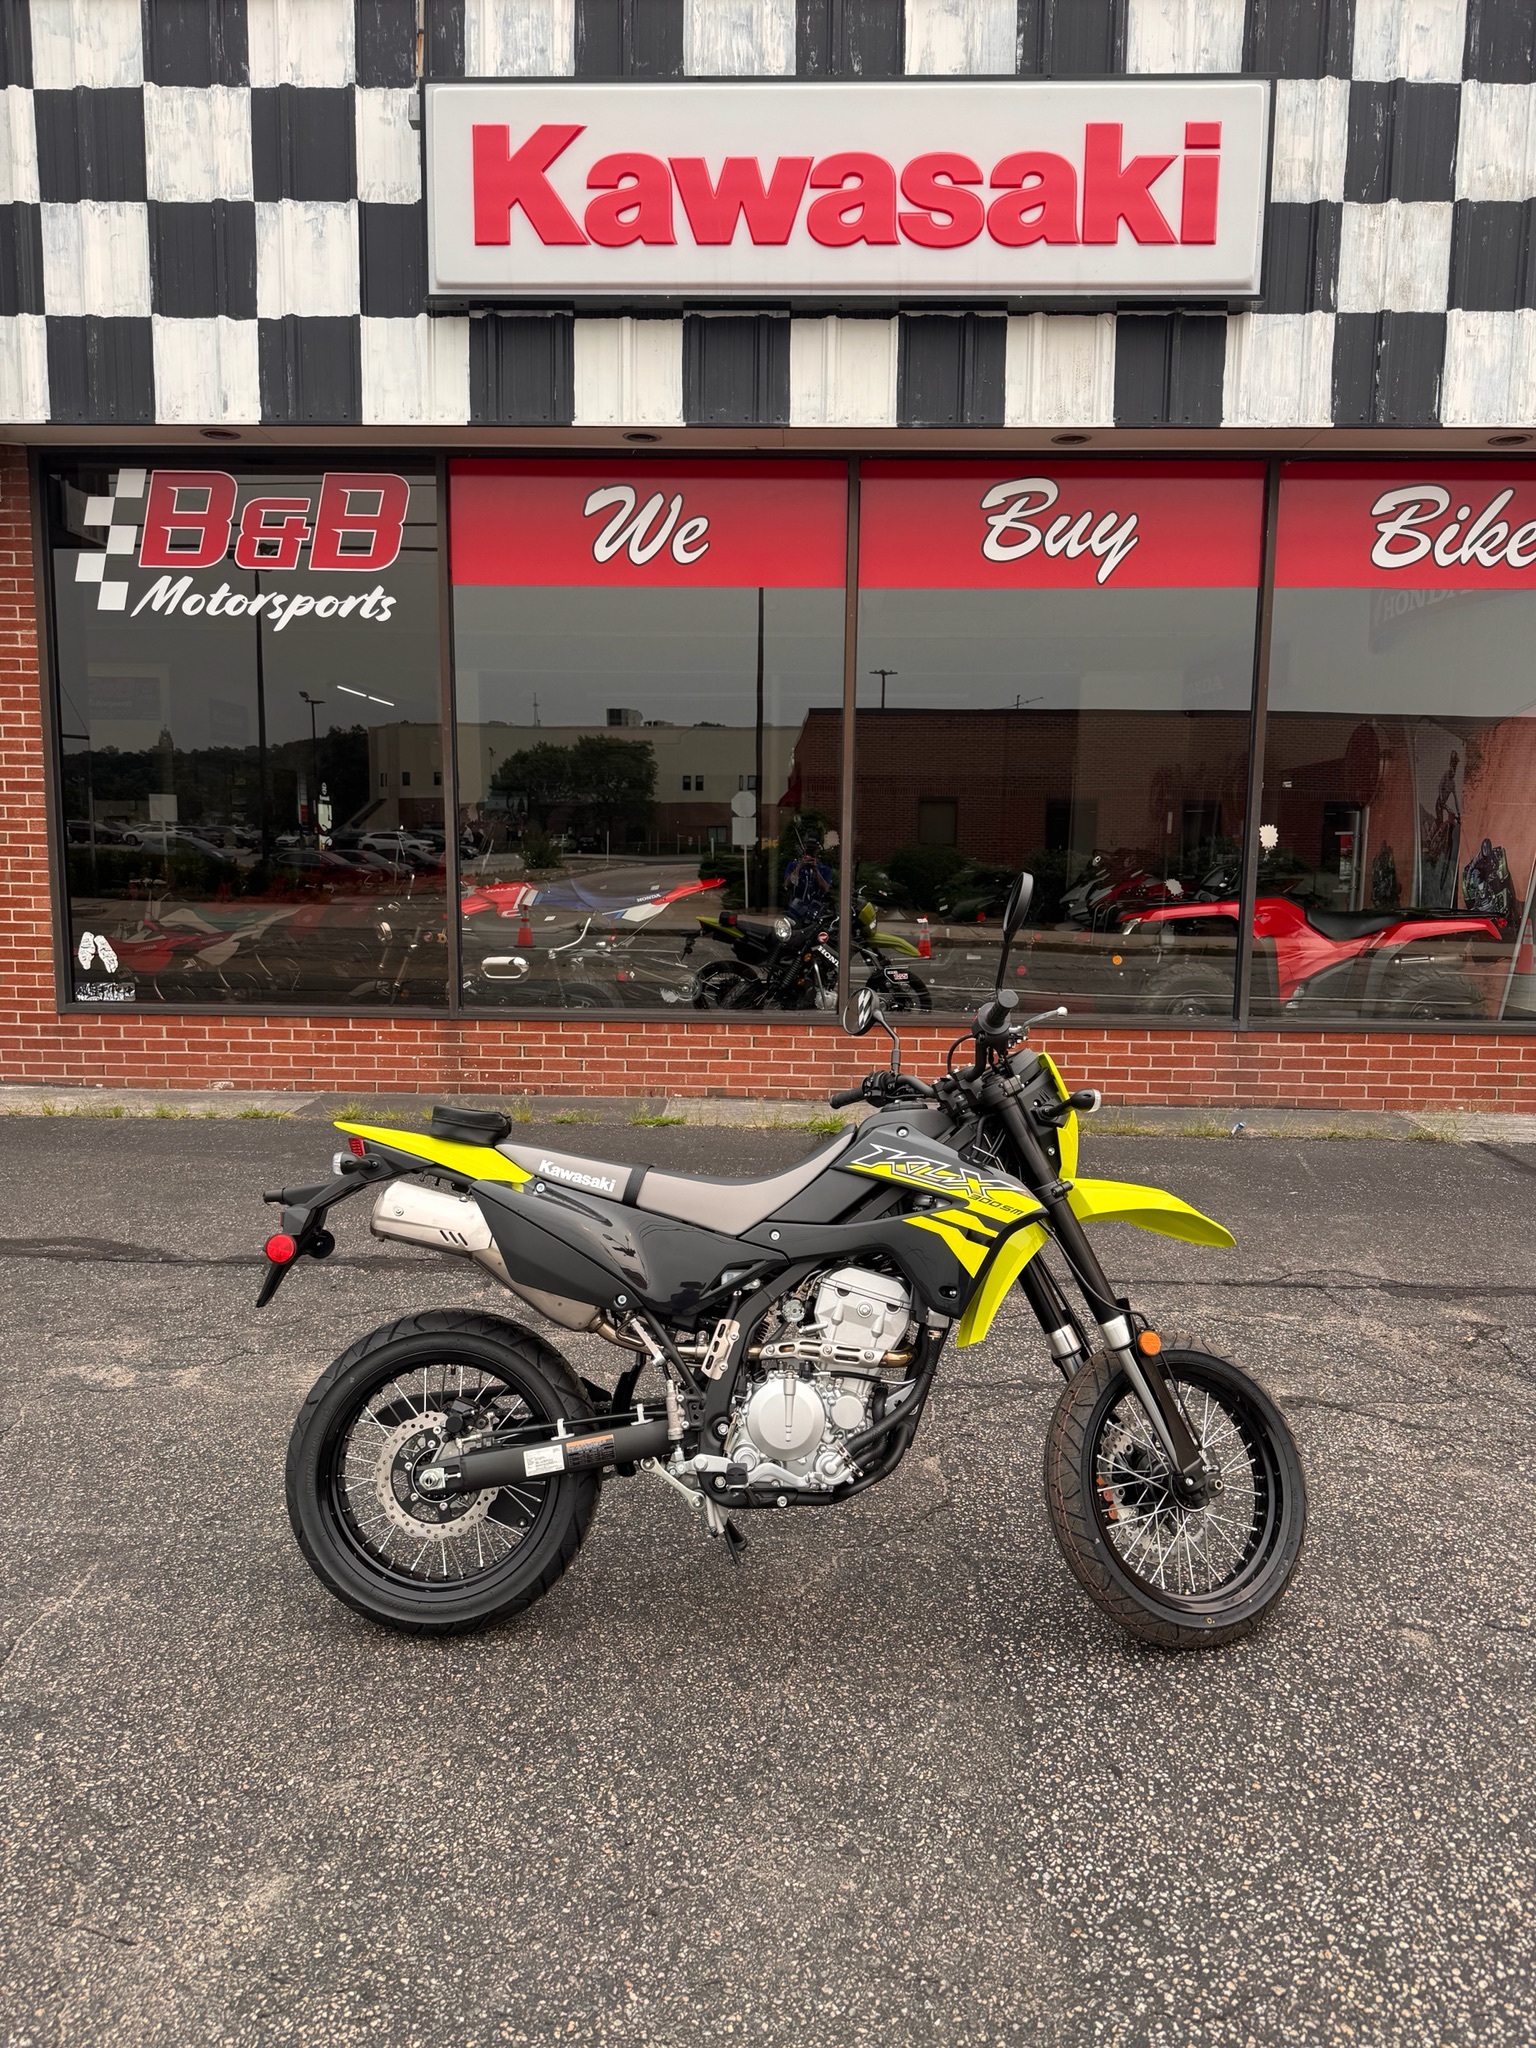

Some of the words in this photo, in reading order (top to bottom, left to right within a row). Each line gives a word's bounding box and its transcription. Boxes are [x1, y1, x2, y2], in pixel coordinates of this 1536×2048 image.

[472, 121, 1222, 249] Kawasaki
[138, 470, 411, 572] B&B
[582, 482, 710, 566] We
[980, 476, 1139, 585] Buy
[1369, 482, 1536, 570] Bike
[130, 574, 397, 632] Motorsports
[636, 893, 661, 902] HONDA
[817, 945, 839, 968] HOND
[538, 1159, 617, 1192] Kawasaki
[850, 1142, 1027, 1199] KLX
